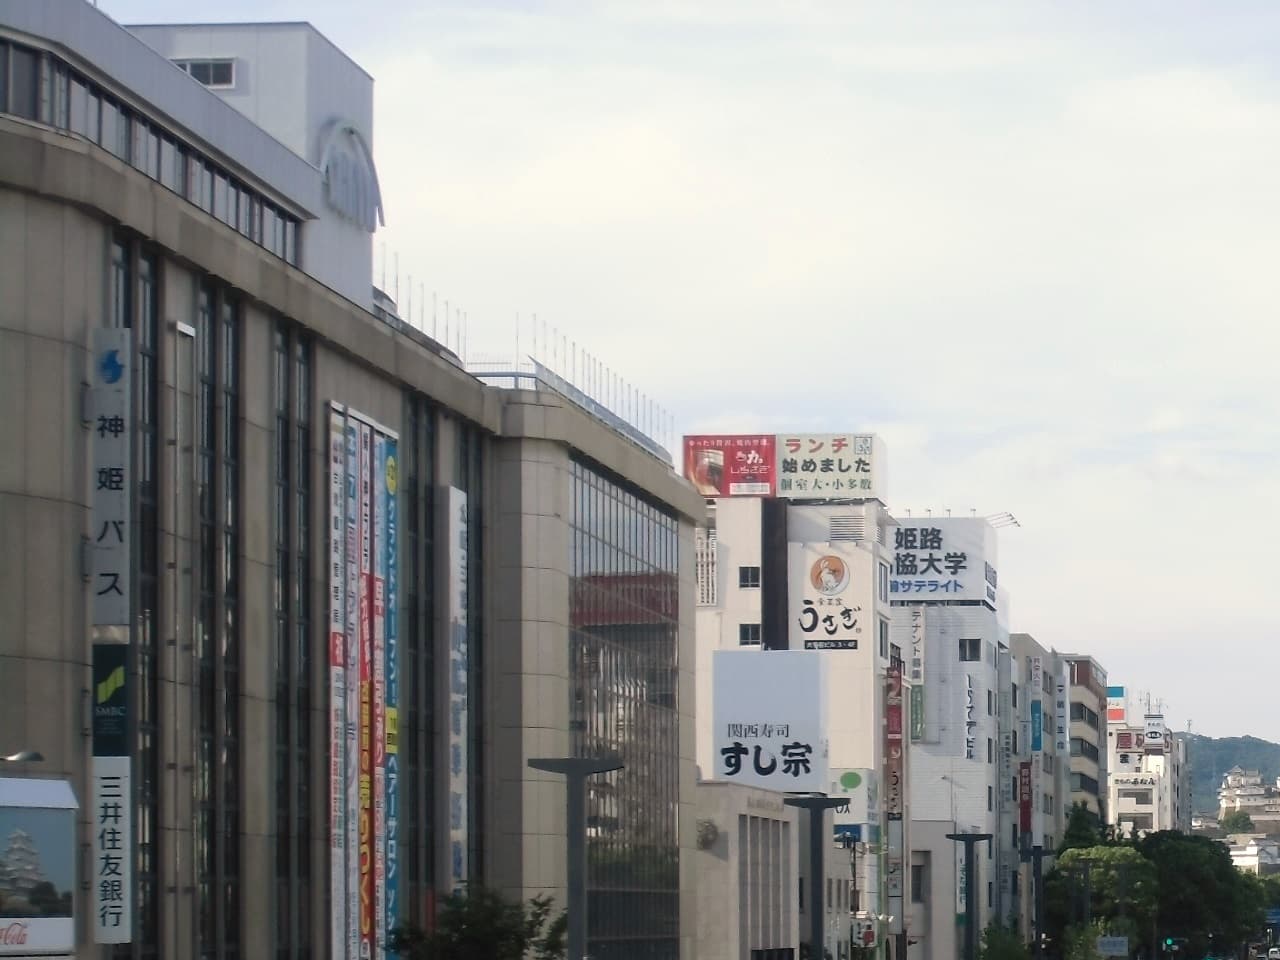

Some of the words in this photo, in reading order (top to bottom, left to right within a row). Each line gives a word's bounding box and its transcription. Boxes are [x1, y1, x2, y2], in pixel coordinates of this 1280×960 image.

[785, 437, 848, 453] ランチ
[782, 458, 871, 473] 始めました
[96, 413, 124, 596] 神姫バス
[894, 527, 943, 550] 姫路
[890, 552, 967, 577] 協大学
[799, 600, 861, 635] うさぎ
[727, 723, 790, 738] 関西寿司
[721, 742, 812, 776] すし宗
[98, 776, 122, 927] 三井住友銀行
